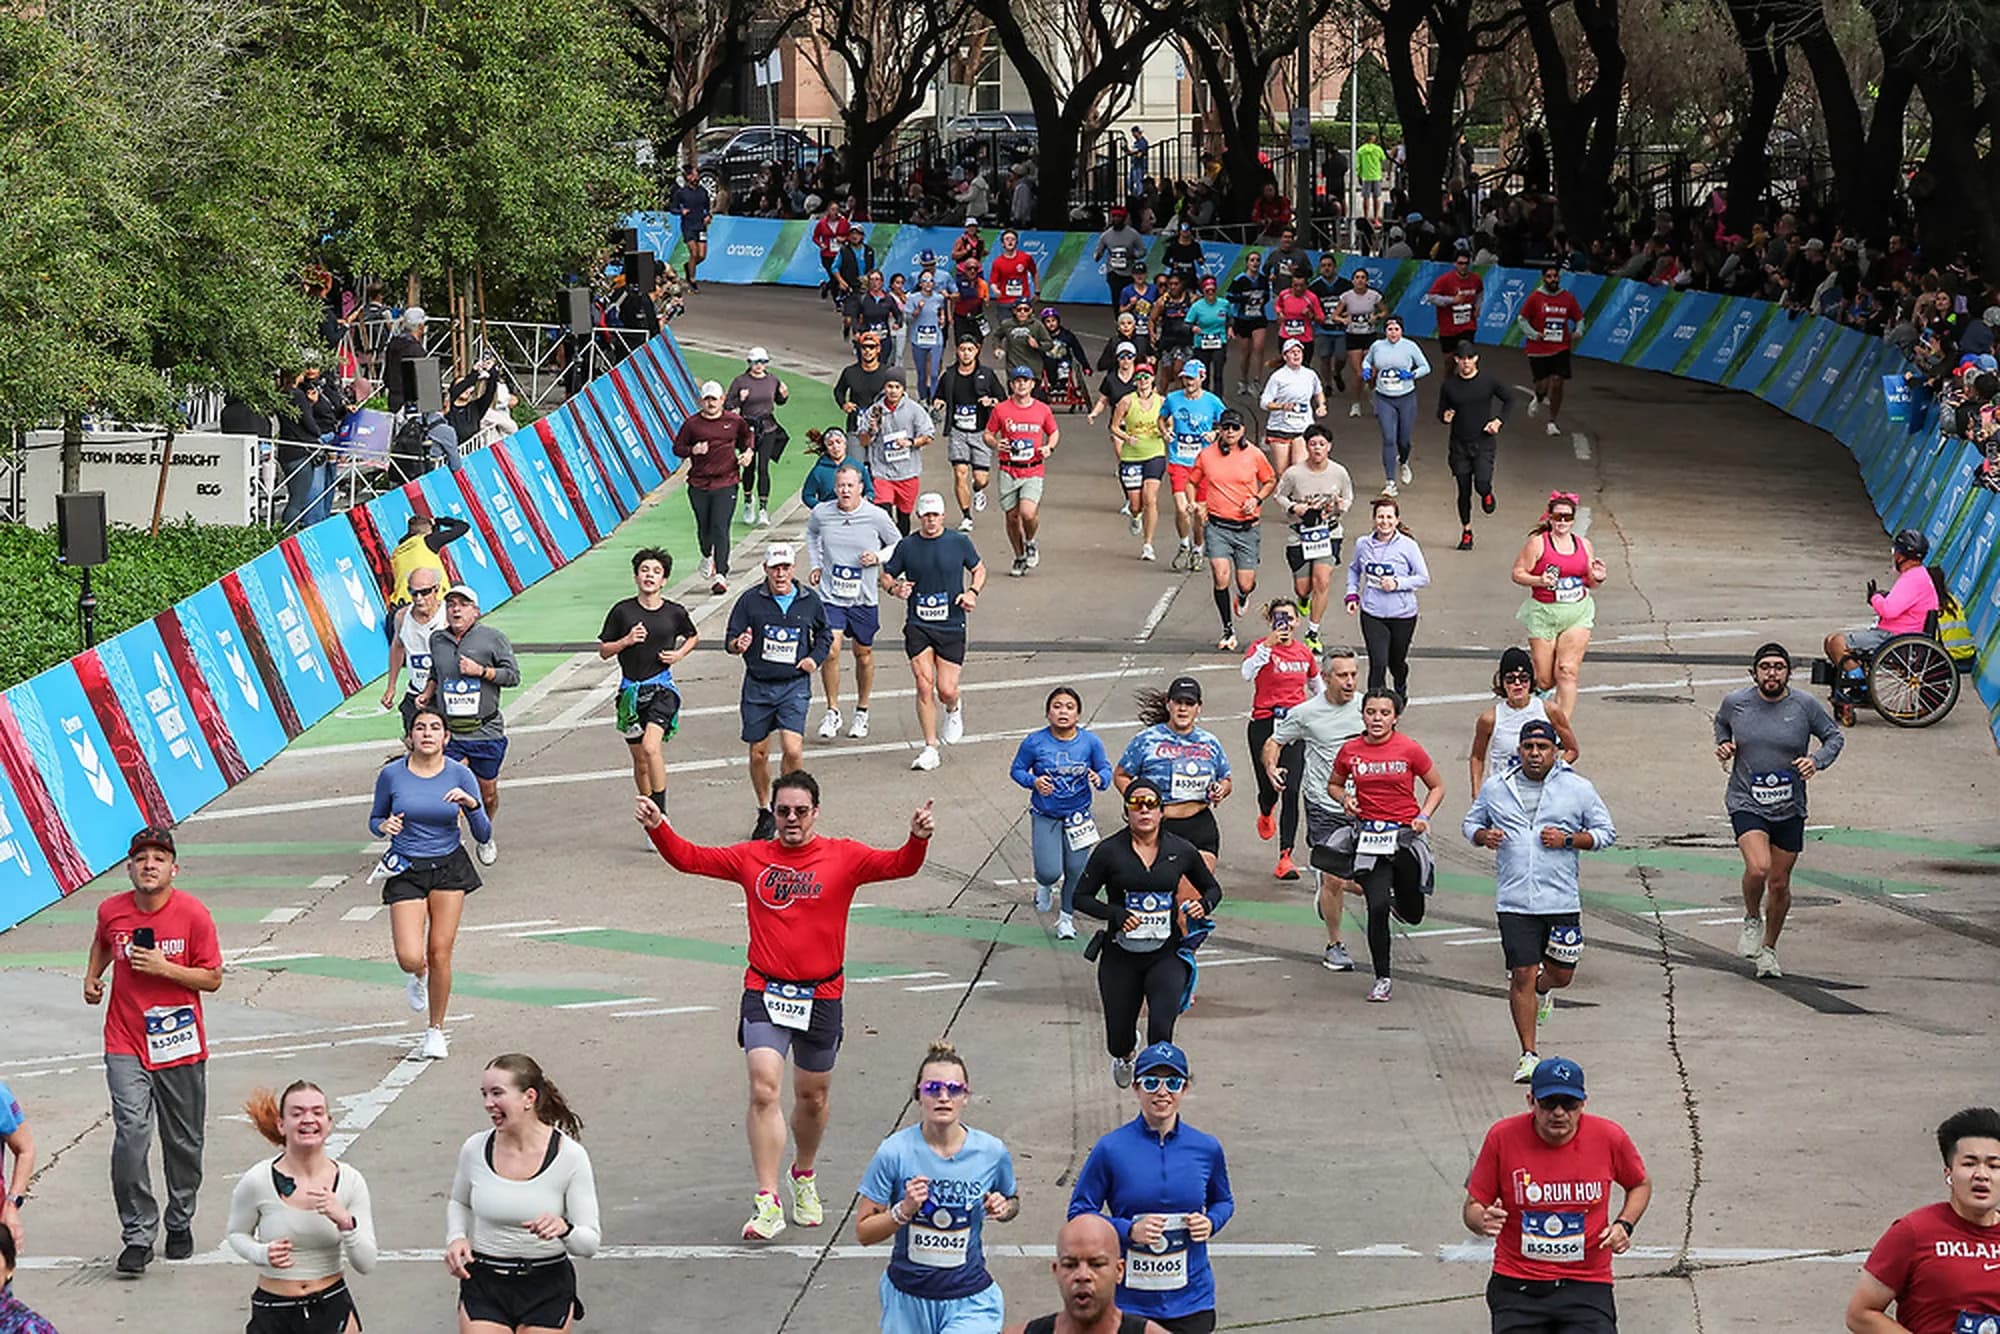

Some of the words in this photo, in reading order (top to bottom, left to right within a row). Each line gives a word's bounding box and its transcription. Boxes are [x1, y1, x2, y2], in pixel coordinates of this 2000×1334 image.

[726, 244, 764, 257] aramco
[115, 453, 146, 465] ROSE
[197, 484, 221, 496] BCG
[1368, 762, 1386, 774] RUN
[161, 939, 184, 955] HOU
[767, 1000, 806, 1016] B51378
[1543, 1183, 1571, 1201] RUN
[1575, 1181, 1602, 1200] HOU
[1527, 1243, 1579, 1254] B53556
[1133, 1259, 1182, 1272] B51605
